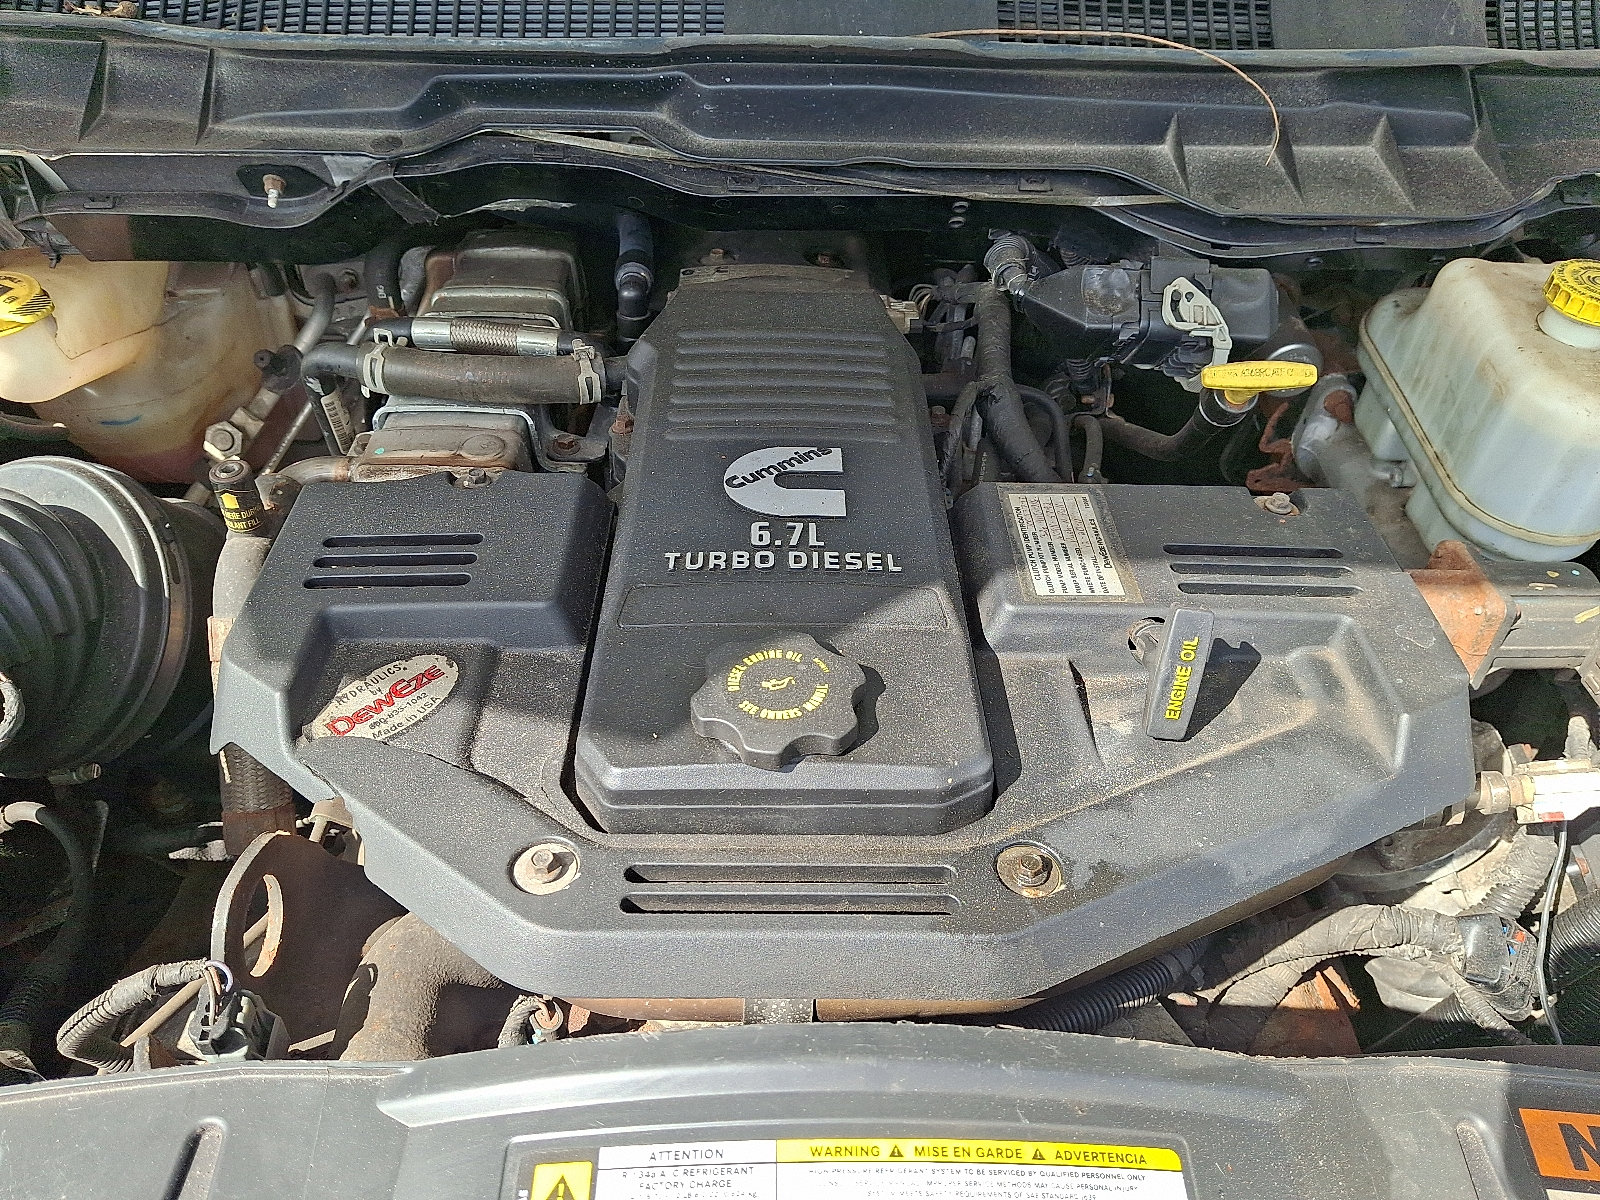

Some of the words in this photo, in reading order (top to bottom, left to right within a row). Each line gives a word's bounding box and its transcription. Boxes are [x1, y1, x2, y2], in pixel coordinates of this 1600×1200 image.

[725, 448, 833, 488] Cummins
[751, 521, 825, 546] 6.7L
[1014, 506, 1030, 543] IDENTIFICATION
[1024, 543, 1035, 558] PUMP
[664, 552, 775, 571] TURBO
[788, 551, 902, 572] DIESEL
[1029, 559, 1041, 580] CLUTCH
[786, 650, 803, 663] OIL
[1164, 665, 1192, 720] ENGINE
[1180, 636, 1200, 662] OIL
[372, 722, 404, 740] Made
[406, 714, 418, 724] in
[419, 695, 441, 714] USA
[649, 1149, 724, 1161] ATTENTION
[810, 1145, 880, 1157] WARNING
[914, 1145, 949, 1157] MISE
[953, 1146, 971, 1158] EN
[976, 1147, 1023, 1159] GARDE
[1054, 1150, 1148, 1165] ADVERTENCIA
[682, 1166, 755, 1177] REFRIGERANT
[988, 1169, 1026, 1177] SERVICED
[1039, 1170, 1080, 1178] QUALIFIED
[1081, 1172, 1125, 1180] PERSONNEL
[689, 1179, 732, 1189] CHARGE
